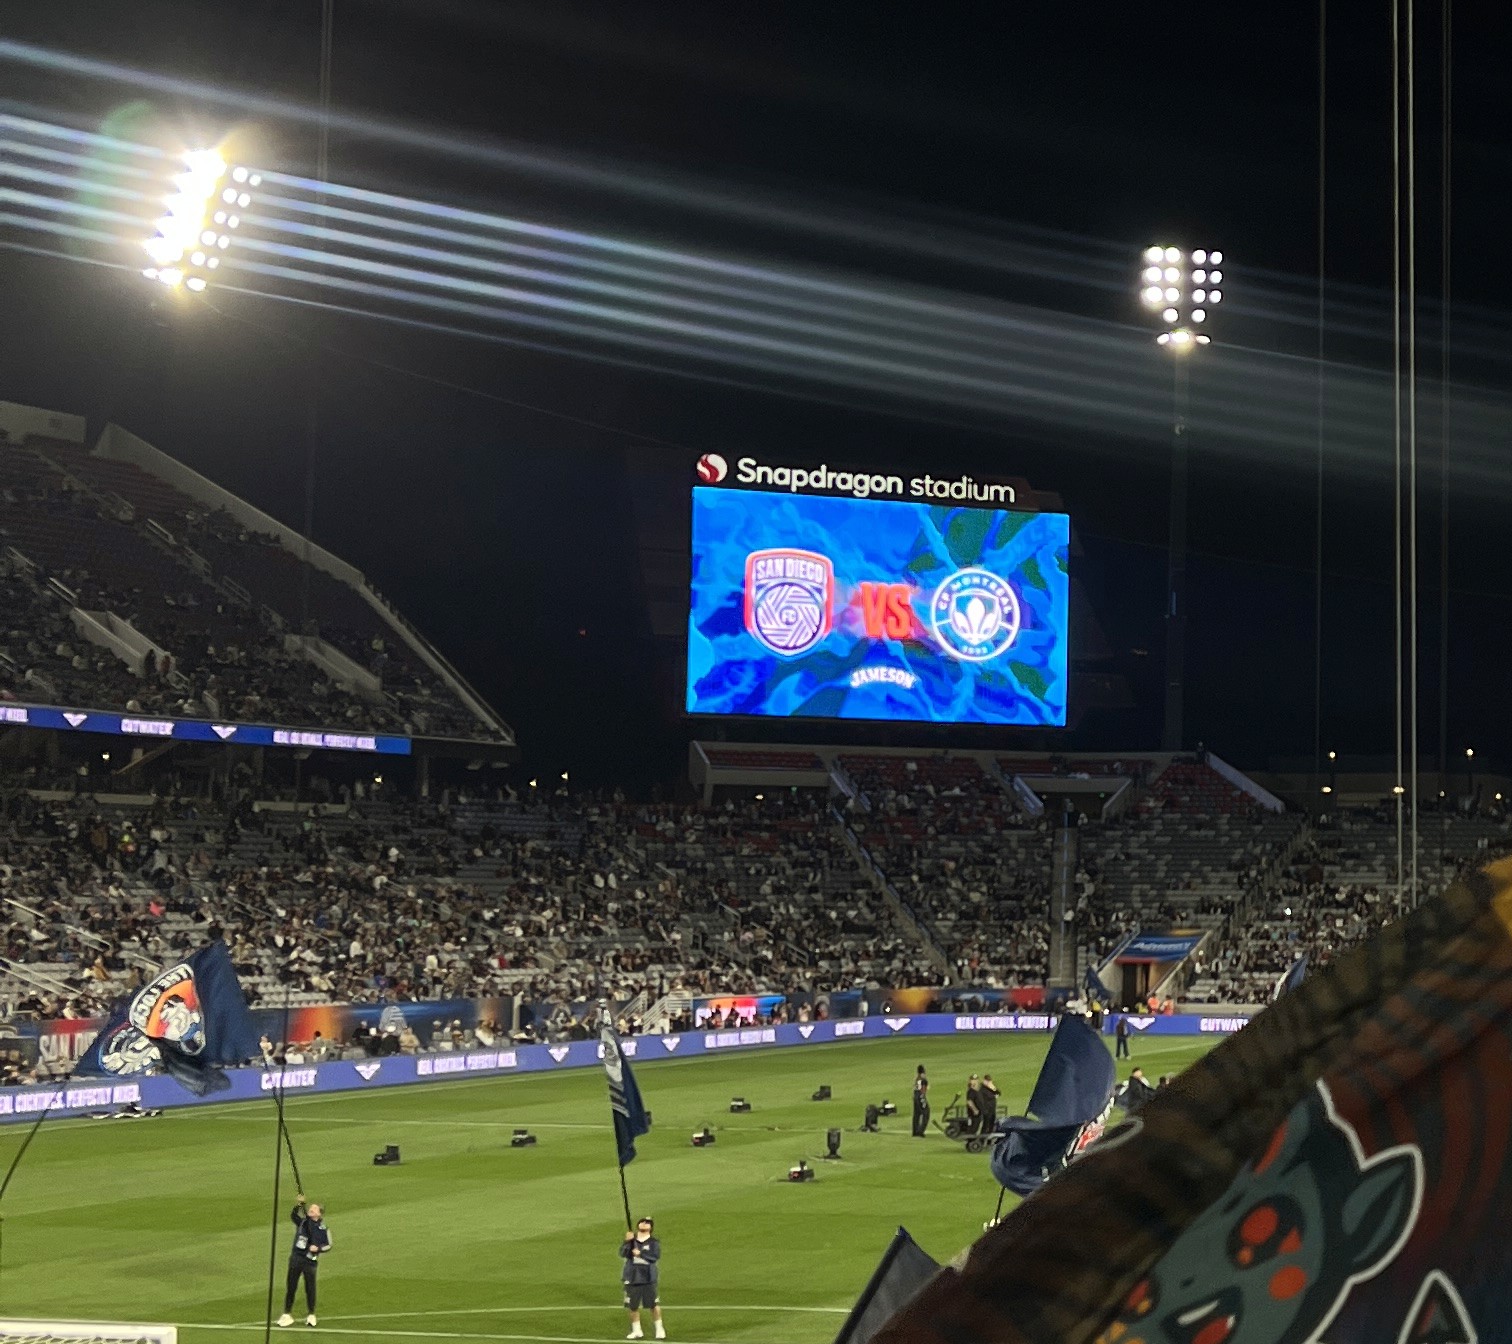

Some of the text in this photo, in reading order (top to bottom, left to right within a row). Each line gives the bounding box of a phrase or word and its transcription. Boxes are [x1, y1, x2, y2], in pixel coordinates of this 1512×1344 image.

[737, 458, 1016, 503] Snapdragon stadium
[755, 558, 825, 585] SAN DIEGO
[860, 582, 913, 640] VS
[850, 666, 919, 689] JAMESON
